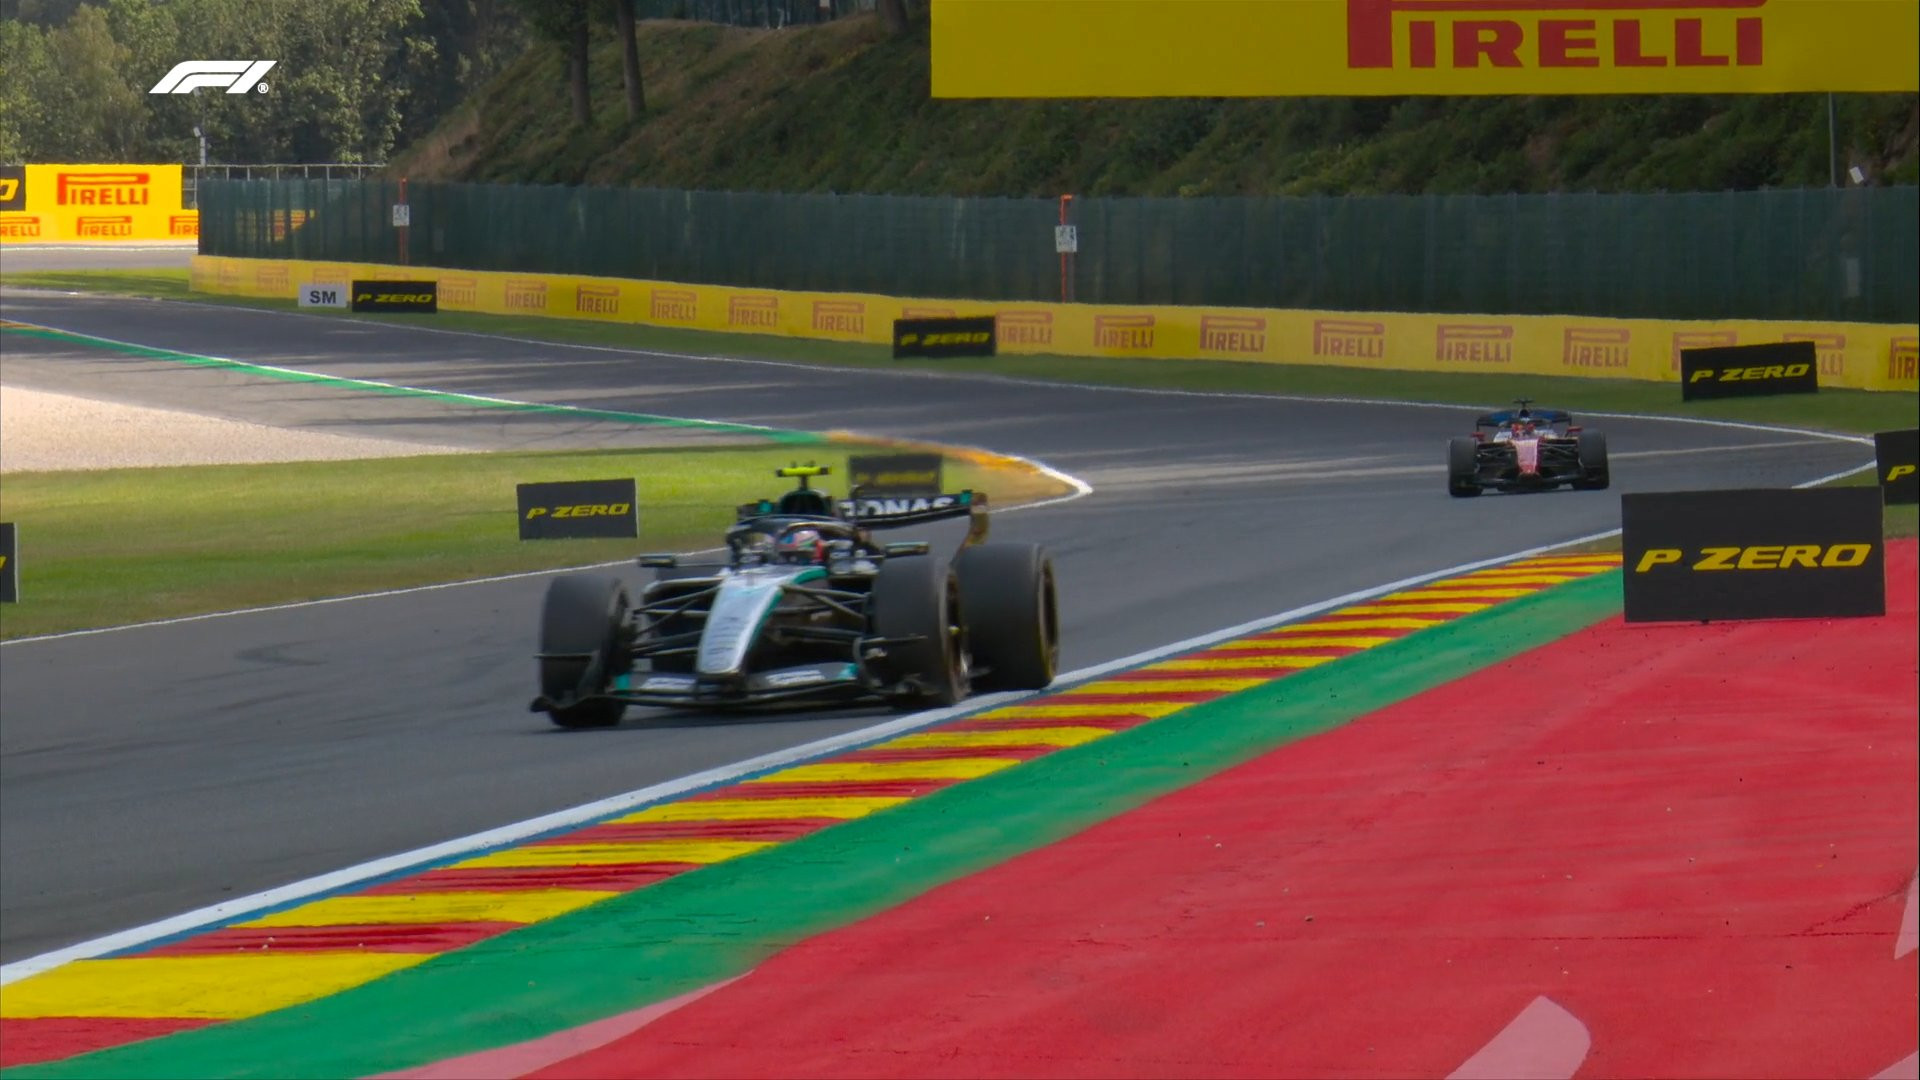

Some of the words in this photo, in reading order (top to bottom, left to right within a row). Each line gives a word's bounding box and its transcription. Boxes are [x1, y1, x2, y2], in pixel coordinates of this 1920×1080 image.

[57, 173, 149, 206] PIRELLI
[76, 216, 133, 236] PIRELLI
[309, 290, 337, 304] SM
[357, 294, 373, 303] P
[374, 293, 433, 303] ZERO
[505, 280, 547, 309] PIRELLI
[575, 283, 619, 314] PIRELLI
[651, 288, 696, 321] PIRELLI
[728, 295, 778, 328] PIRELLI
[812, 300, 864, 334] PIRELLI
[902, 334, 918, 346] P
[921, 332, 989, 346] ZERO
[1093, 314, 1155, 348] PIRELLI
[1200, 315, 1266, 353] PIRELLI
[1313, 319, 1384, 359] PIRELLI
[1436, 324, 1514, 363] PIRELLI
[1563, 328, 1630, 368] PIRELLI
[1689, 370, 1714, 383] P
[1719, 363, 1810, 382] ZERO
[1886, 464, 1917, 482] P
[526, 507, 547, 520] P
[550, 503, 631, 519] ZERO
[1635, 549, 1683, 573] P
[1692, 543, 1872, 571] ZERO
